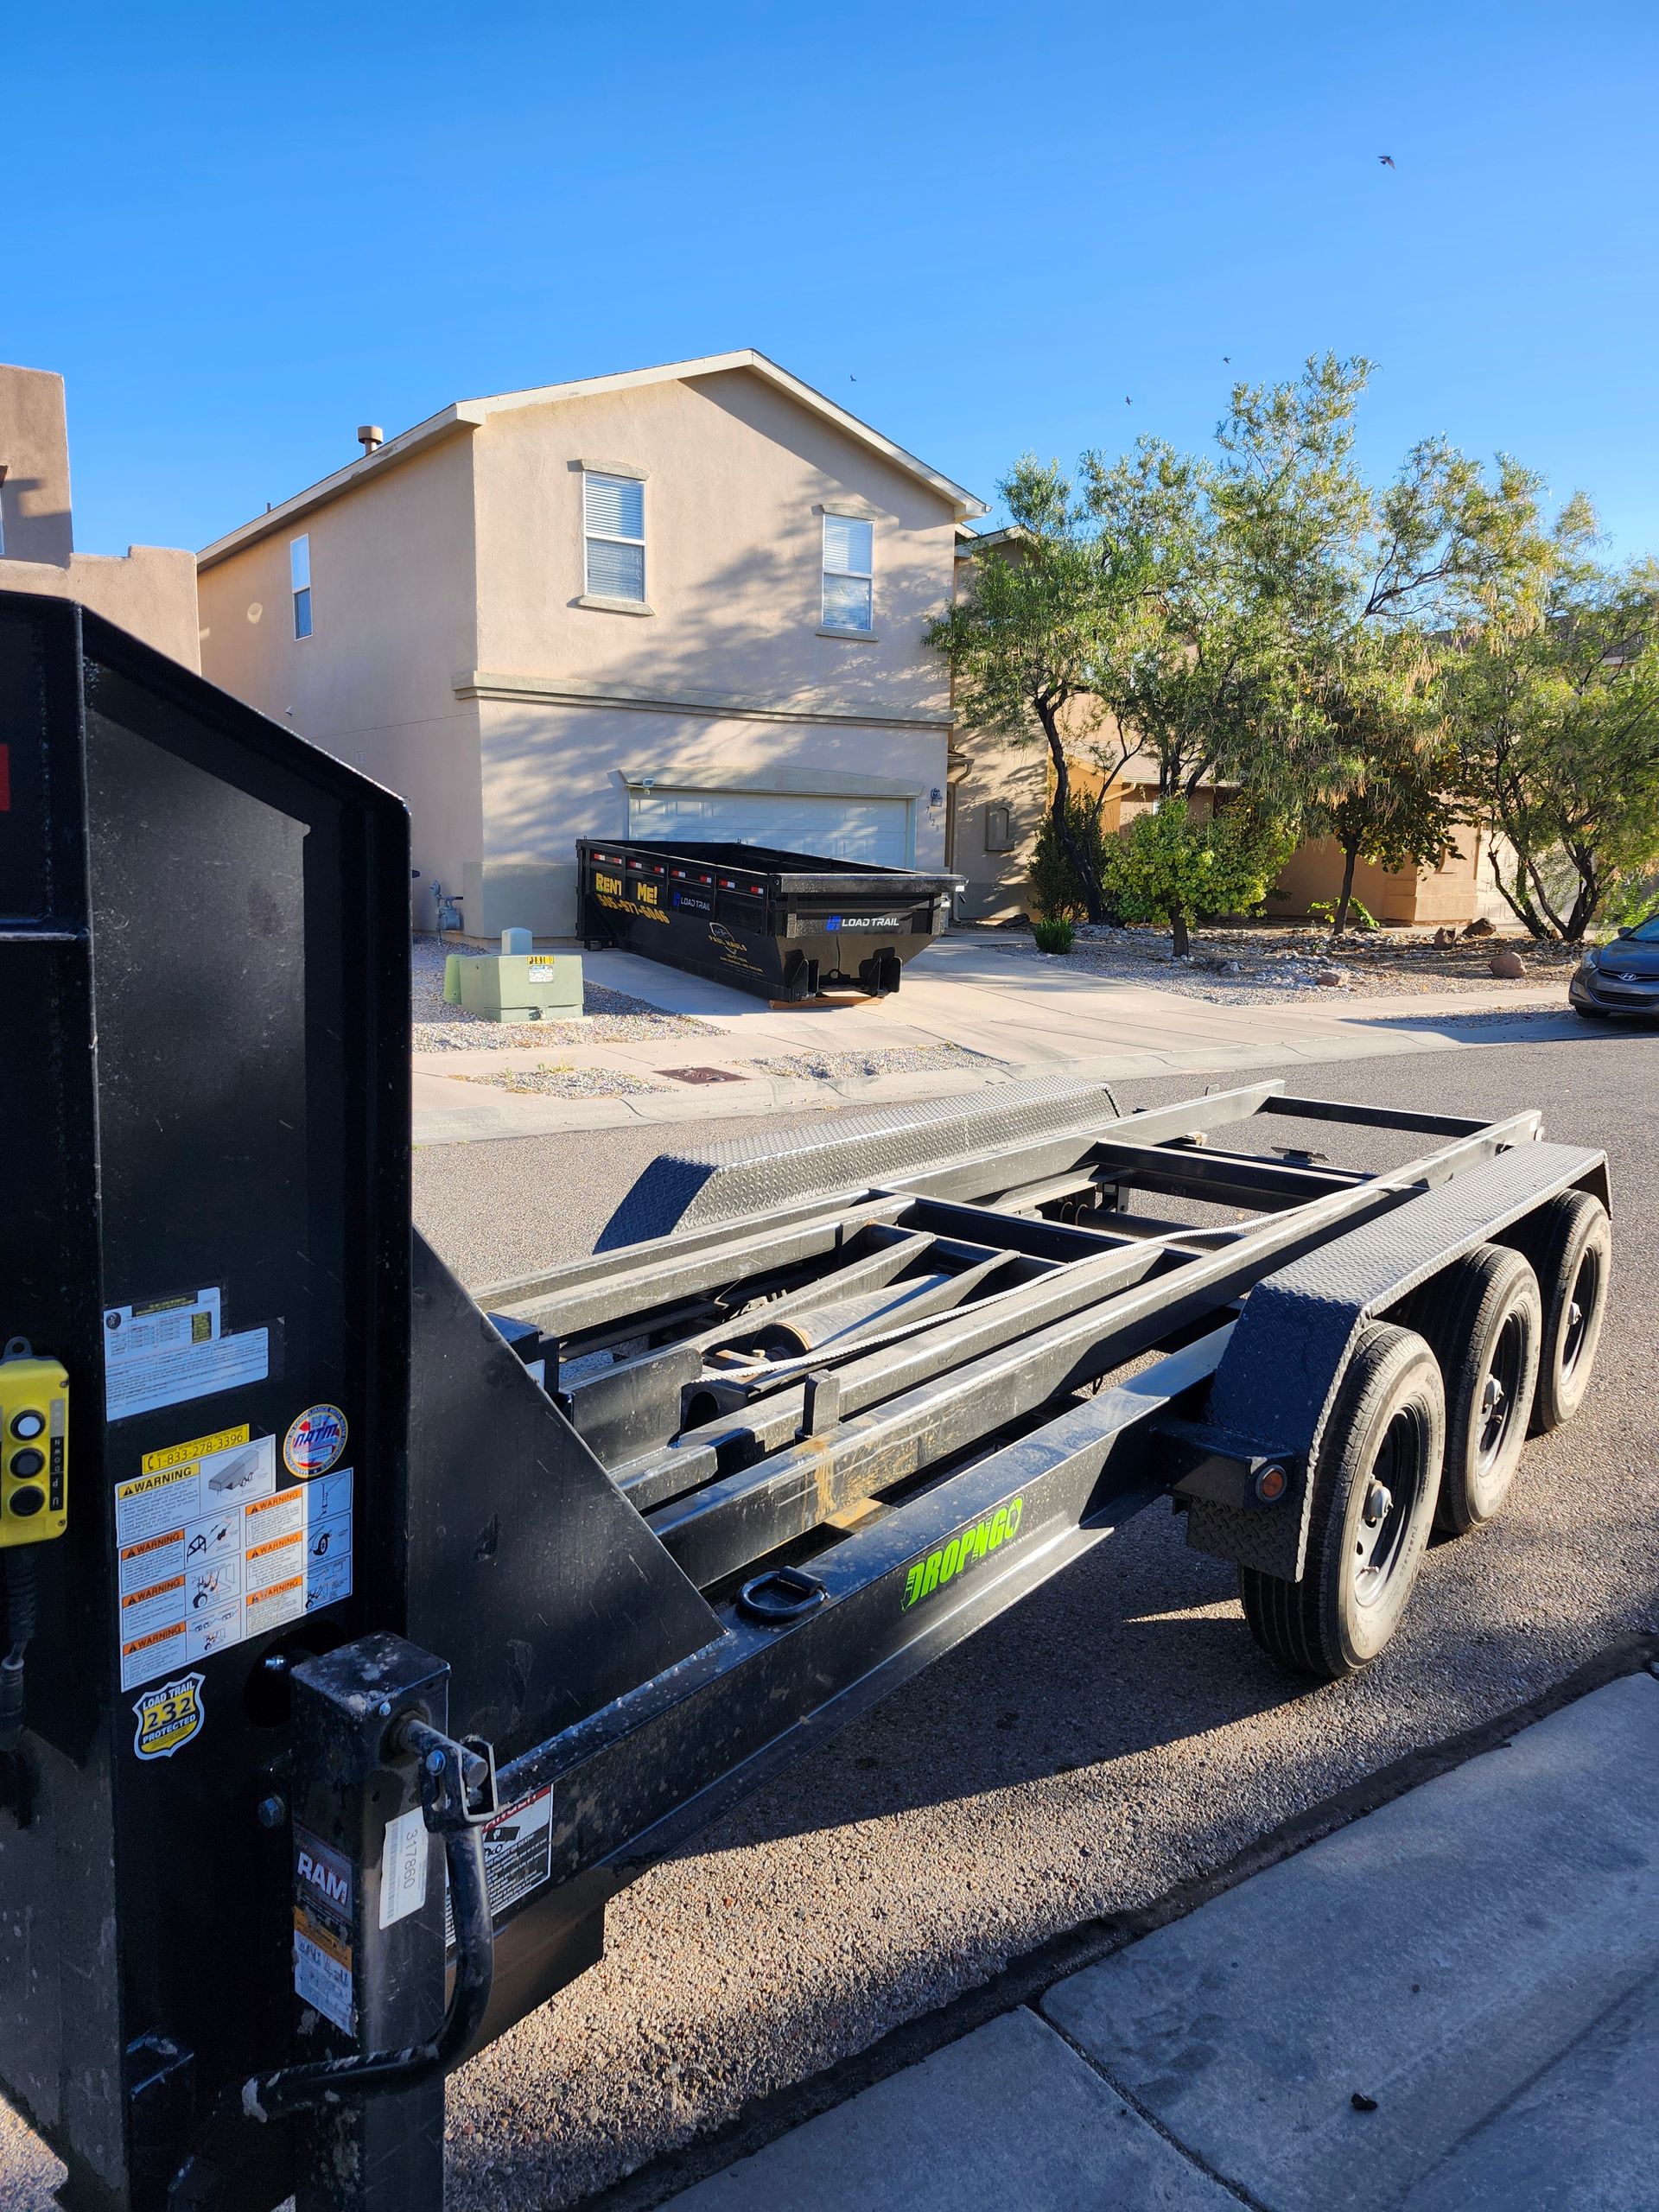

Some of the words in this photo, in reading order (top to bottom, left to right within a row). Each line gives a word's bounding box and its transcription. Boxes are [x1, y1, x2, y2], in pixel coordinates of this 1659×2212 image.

[596, 873, 622, 896] RENT
[638, 882, 658, 905] ME!
[596, 893, 671, 925] 505-977-6046
[680, 897, 695, 907] LOAD
[696, 900, 710, 912] TRAIL
[842, 918, 870, 927] LOAD
[872, 918, 899, 926] TRAIL
[157, 1432, 243, 1465] 1-833-278-3396
[53, 1478, 59, 1506] UP
[135, 1466, 192, 1493] WARNING
[260, 1491, 299, 1510] WARNING
[137, 1531, 180, 1553] WARNING
[260, 1534, 299, 1554] WARNING
[137, 1578, 181, 1600] WARNING
[138, 1624, 181, 1648] WARNING
[143, 1693, 167, 1710] LOAD
[168, 1681, 195, 1698] TRAIL
[148, 1697, 191, 1729] 232
[143, 1713, 196, 1745] PROTECTED
[404, 1829, 418, 1890] 317860
[298, 1852, 348, 1905] RAM
